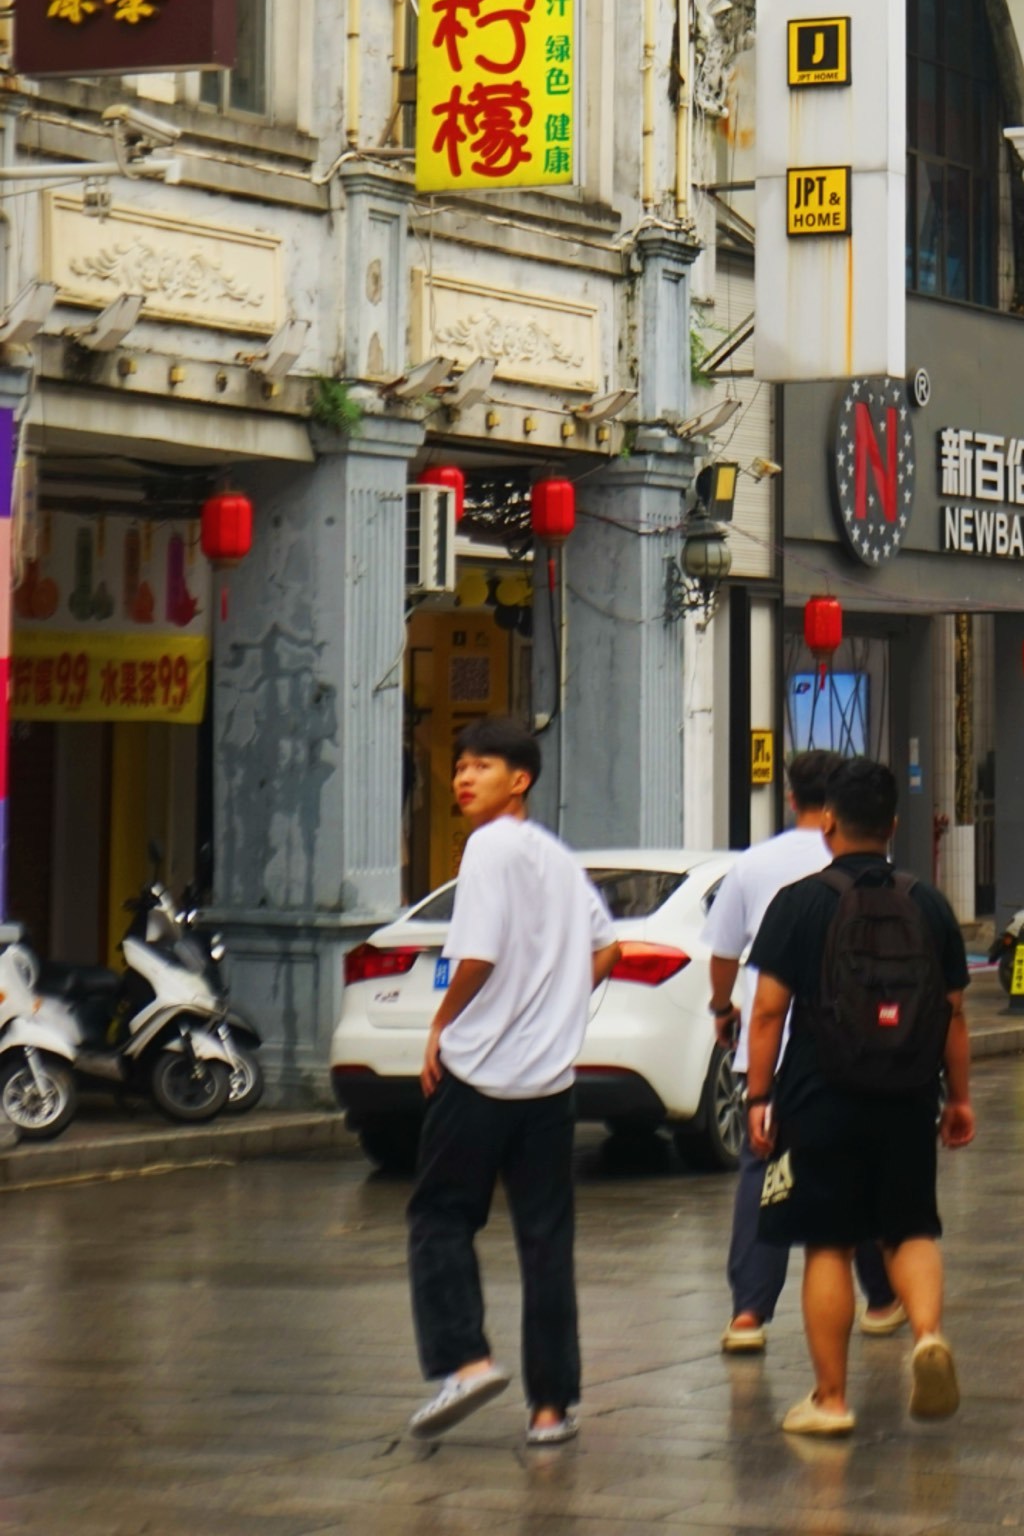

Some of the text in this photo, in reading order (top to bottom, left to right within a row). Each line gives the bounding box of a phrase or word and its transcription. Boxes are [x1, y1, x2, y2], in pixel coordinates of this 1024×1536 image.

[811, 31, 825, 64] J
[797, 72, 839, 82] JPT HOME
[795, 176, 827, 209] JPT
[793, 212, 841, 228] HOME
[855, 401, 898, 524] N
